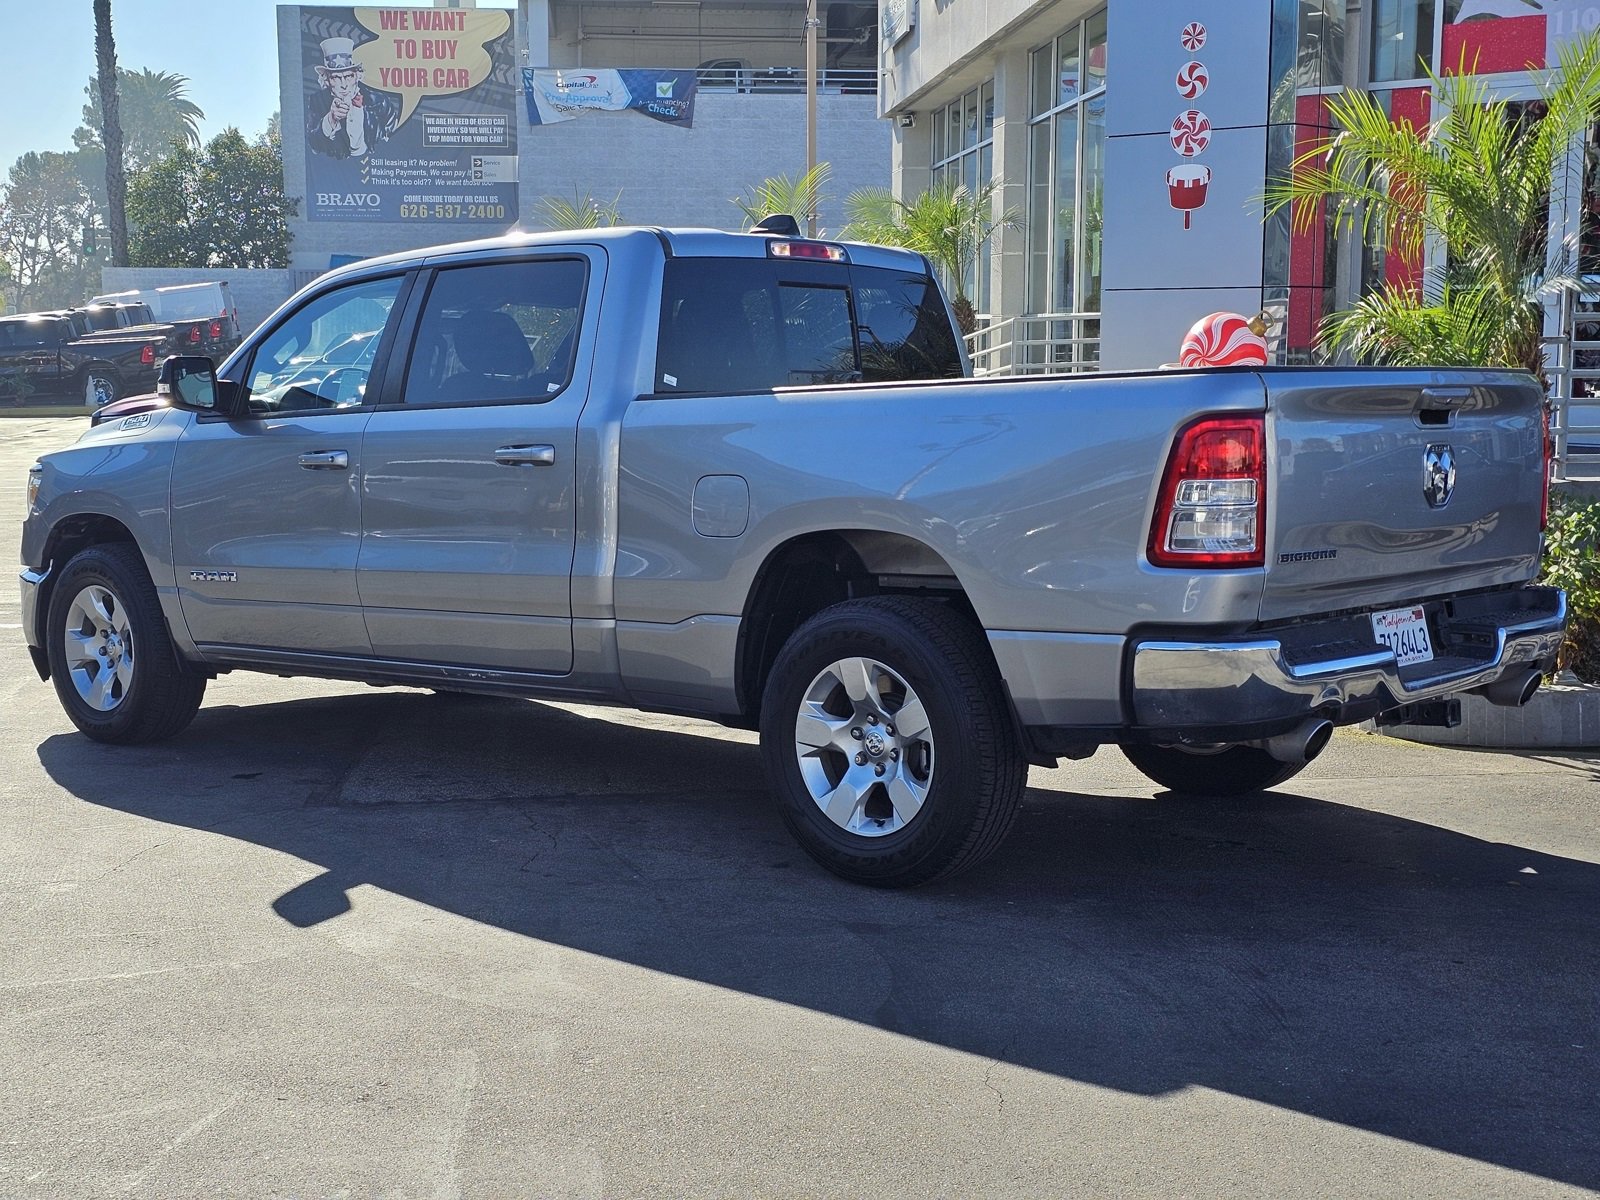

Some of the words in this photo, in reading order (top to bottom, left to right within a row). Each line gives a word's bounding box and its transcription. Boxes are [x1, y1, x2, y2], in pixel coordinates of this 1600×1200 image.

[379, 10, 408, 31] WE
[412, 11, 466, 31] WANT
[393, 38, 417, 59] TO
[421, 39, 458, 60] BUY
[379, 67, 428, 88] YOUR
[433, 67, 470, 88] CAR
[647, 103, 678, 117] Check.
[425, 117, 435, 125] WE
[435, 117, 447, 125] ARE
[447, 117, 454, 125] IN
[459, 126, 468, 134] SO
[468, 126, 478, 134] WE
[478, 126, 493, 134] WILL
[493, 126, 504, 134] PAY
[428, 135, 440, 143] TOP
[440, 135, 460, 143] MONEY
[461, 135, 473, 143] FOR
[473, 135, 489, 143] YOUR
[370, 158, 384, 166] Still
[384, 158, 408, 168] leasing
[408, 158, 418, 166] it?
[428, 159, 458, 168] problem!
[371, 168, 394, 177] Making
[395, 168, 429, 177] Payments,
[430, 168, 440, 176] We
[453, 170, 467, 178] pay
[371, 177, 390, 185] Think
[401, 178, 413, 186] too
[413, 178, 432, 186] old??
[435, 178, 445, 186] We
[315, 193, 381, 206] BRAVO
[403, 194, 422, 203] COME
[422, 195, 444, 203] INSIDE
[444, 195, 464, 203] TODAY
[464, 195, 474, 203] OR
[474, 195, 489, 203] CALL
[489, 195, 499, 203] US
[400, 204, 505, 219] 626-537-2400
[190, 570, 238, 582] RAM
[1384, 613, 1416, 629] California
